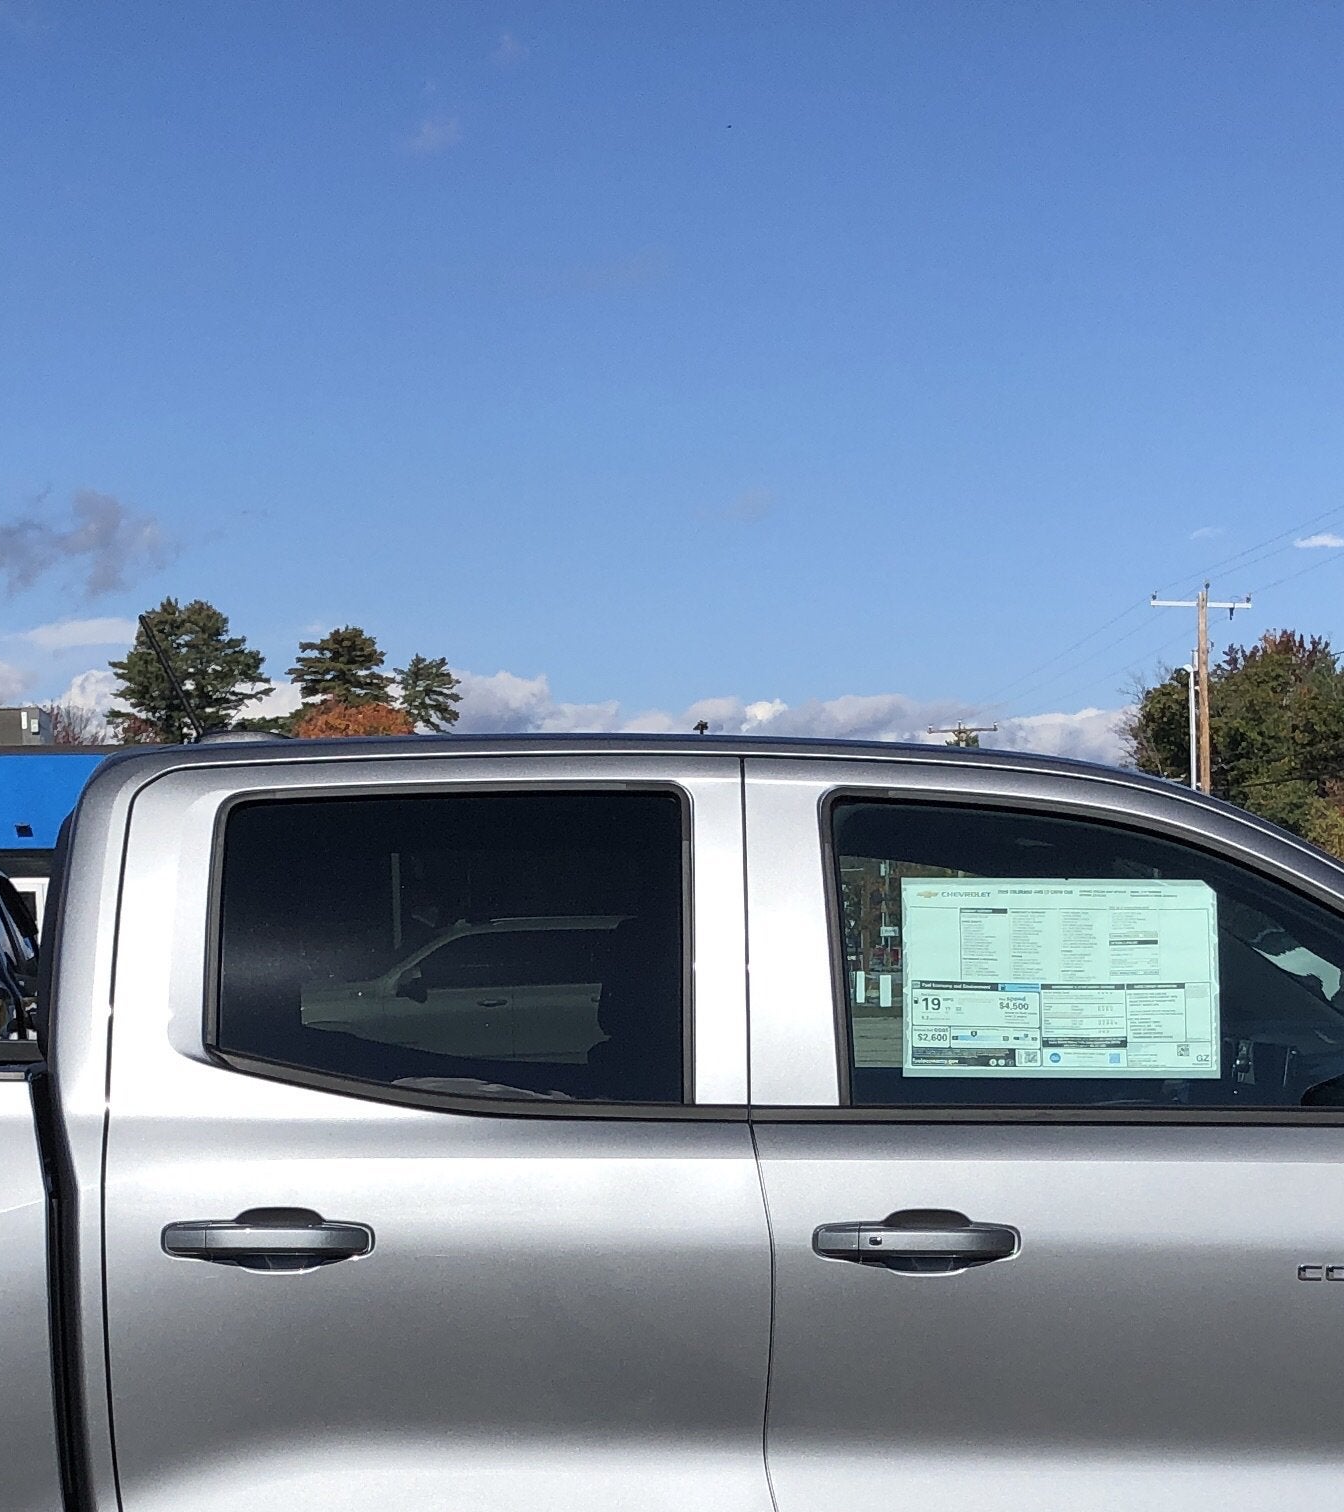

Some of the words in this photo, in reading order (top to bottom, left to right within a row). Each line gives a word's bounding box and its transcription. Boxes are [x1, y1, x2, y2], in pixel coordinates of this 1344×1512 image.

[921, 997, 941, 1011] 19
[999, 1001, 1029, 1011] $4,500
[917, 1033, 948, 1042] $2,600
